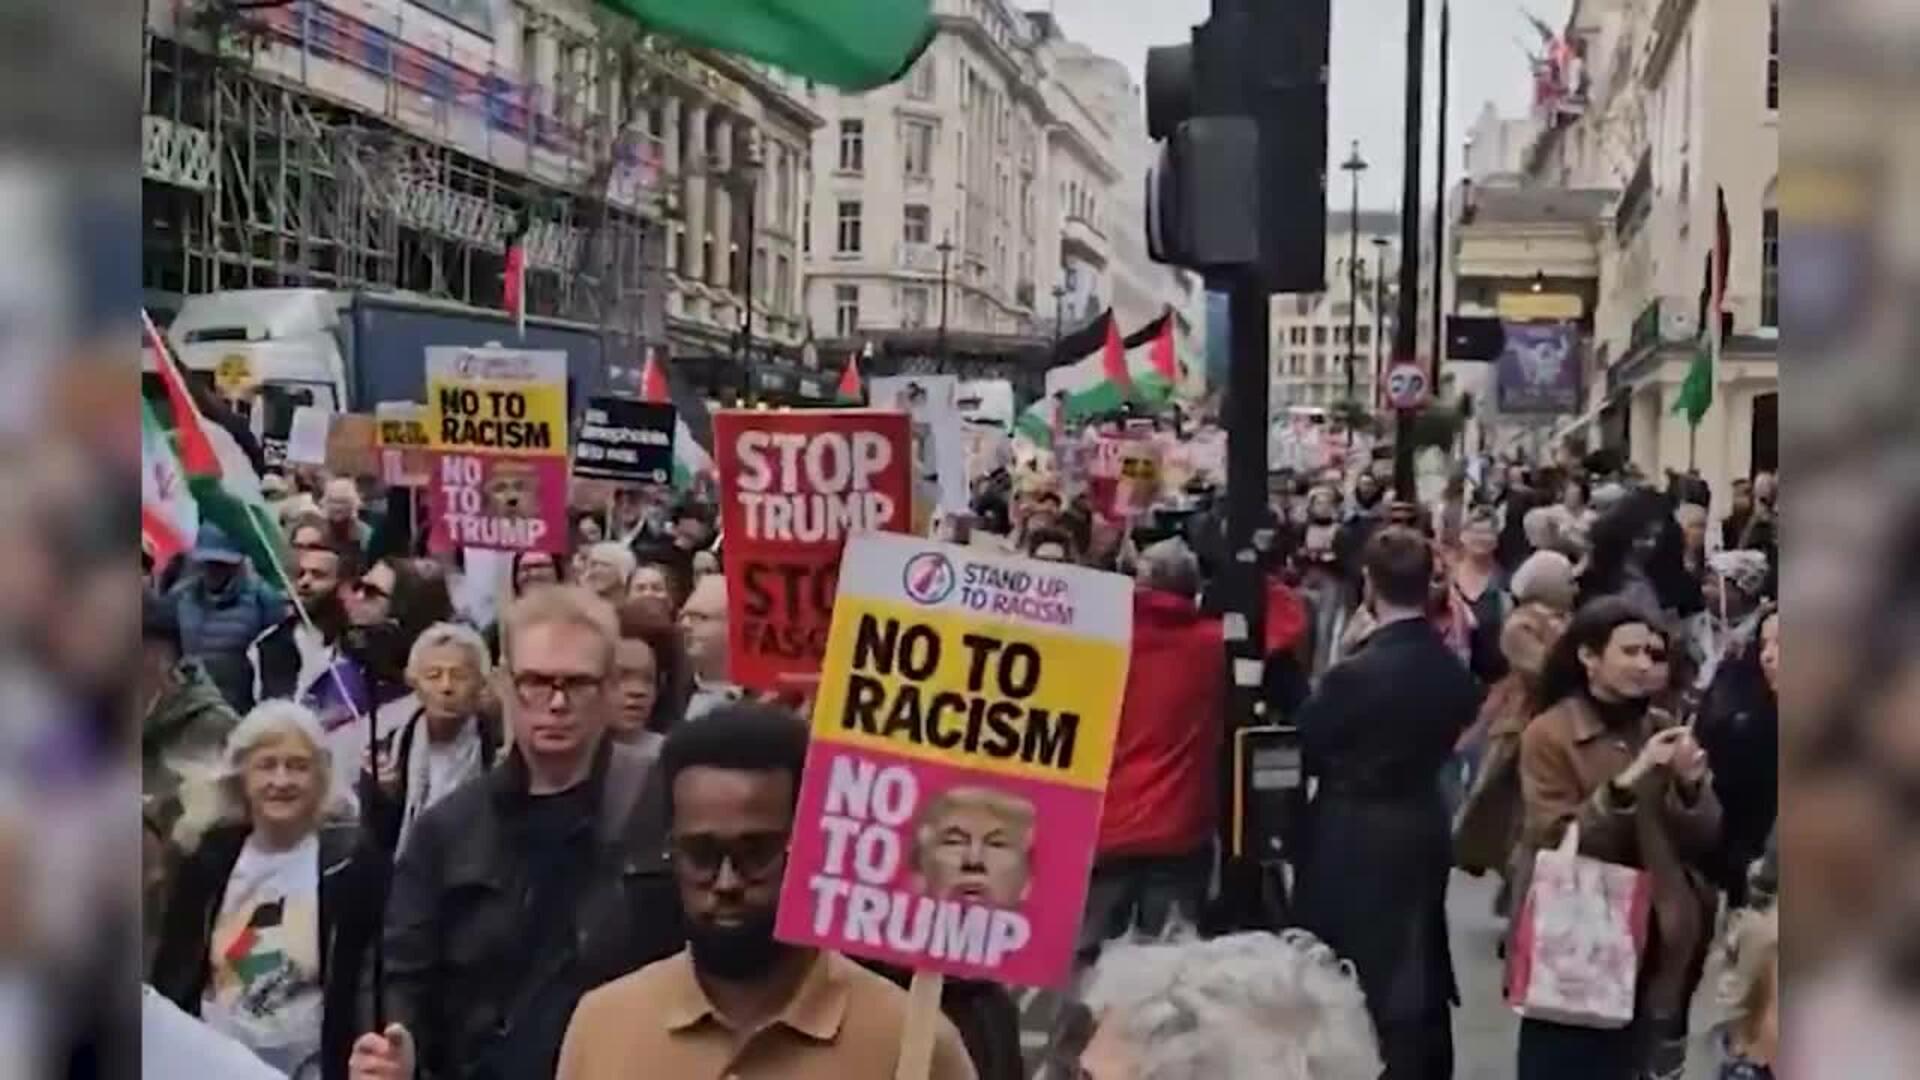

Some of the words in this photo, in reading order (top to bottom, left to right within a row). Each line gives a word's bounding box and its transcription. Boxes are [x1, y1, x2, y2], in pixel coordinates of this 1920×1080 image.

[441, 387, 479, 416] NO
[487, 390, 526, 419] TO
[442, 417, 551, 448] RACISM
[442, 455, 482, 486] NO
[736, 430, 892, 494] STOP
[442, 485, 481, 514] TO
[737, 491, 895, 542] TRUMP
[443, 513, 547, 547] TRUMP
[744, 560, 839, 622] STO
[964, 562, 1031, 593] STAND
[1036, 576, 1068, 599] UP
[961, 586, 987, 611] TO
[993, 592, 1075, 625] RACISM
[743, 620, 828, 661] FASC
[852, 613, 941, 681] NO
[962, 634, 1041, 699] TO
[842, 674, 1080, 769] RACISM
[825, 755, 919, 826] NO
[820, 814, 900, 885] TO
[810, 875, 1031, 967] TRUMP
